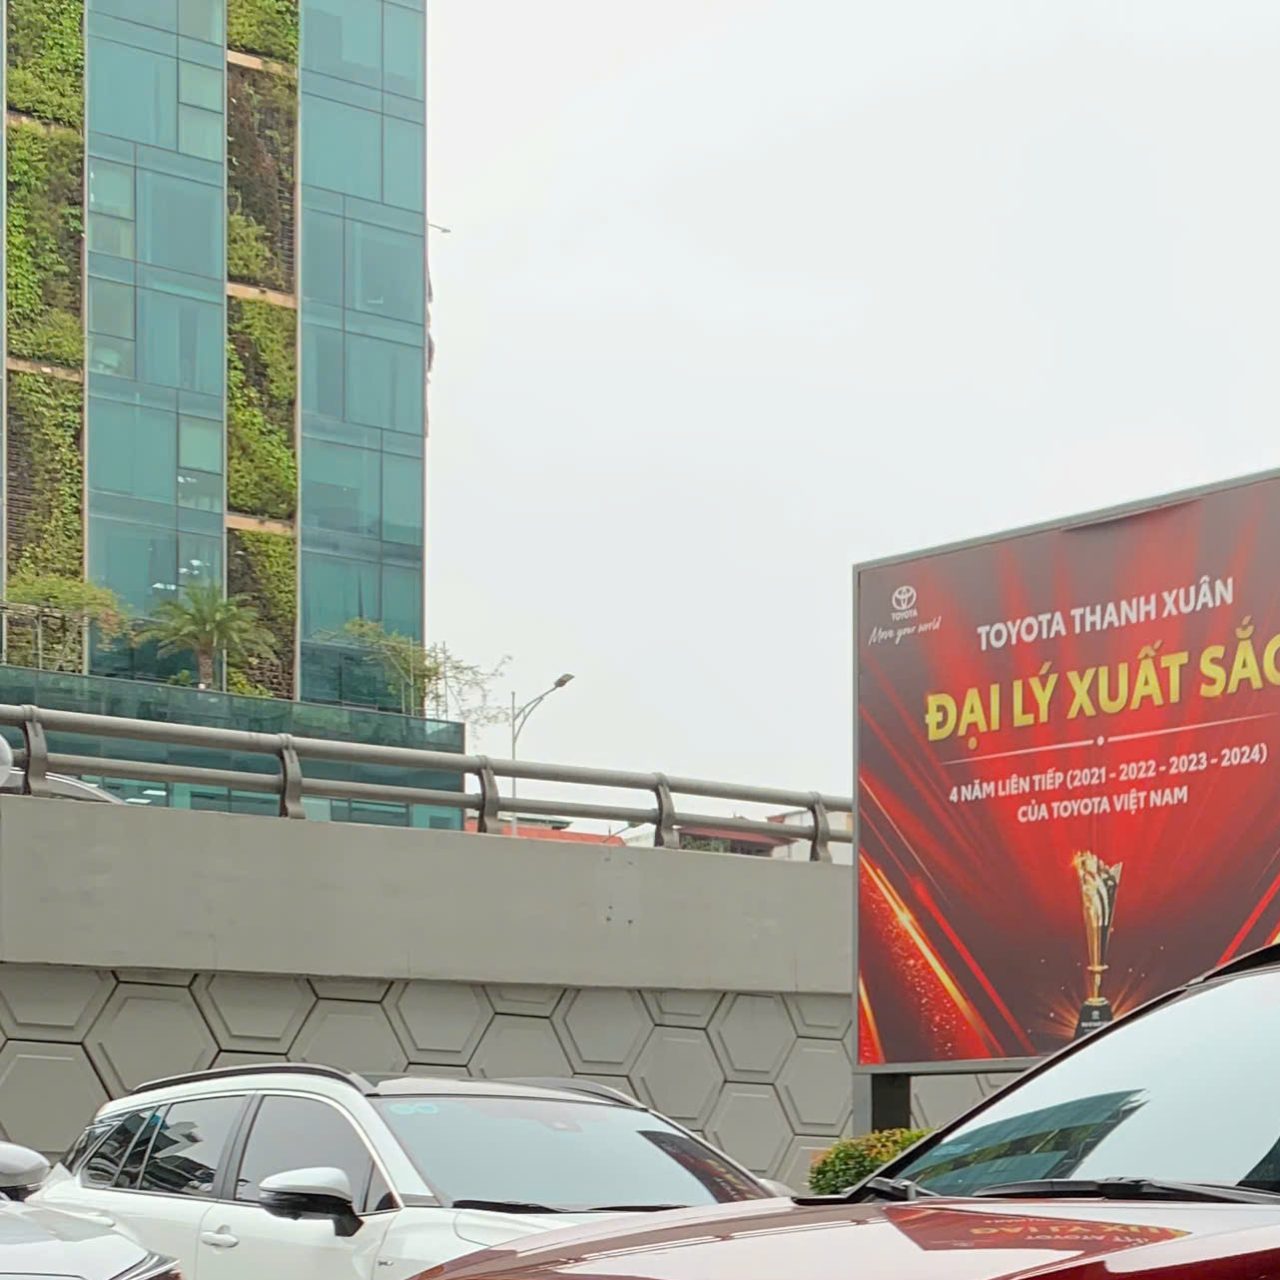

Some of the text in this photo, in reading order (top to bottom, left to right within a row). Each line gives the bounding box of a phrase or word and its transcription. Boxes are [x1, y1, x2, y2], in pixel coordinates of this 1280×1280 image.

[891, 608, 918, 622] TOYOTA
[977, 576, 1234, 651] TOYOTA THANH XUÂN
[925, 682, 1000, 750] ĐẠI
[1013, 661, 1058, 728] LÝ
[1067, 639, 1189, 719] XUẤT
[949, 788, 958, 803] 4
[960, 780, 995, 801] NĂM
[998, 774, 1030, 796] LIÊN
[1033, 766, 1064, 791] TIẾP
[1066, 767, 1106, 790] (2021
[1119, 760, 1157, 782] 2022
[1169, 752, 1208, 774] 2023
[1221, 742, 1268, 768] 2024)
[1018, 786, 1188, 823] CỦA TOYOTA VIỆT NAM
